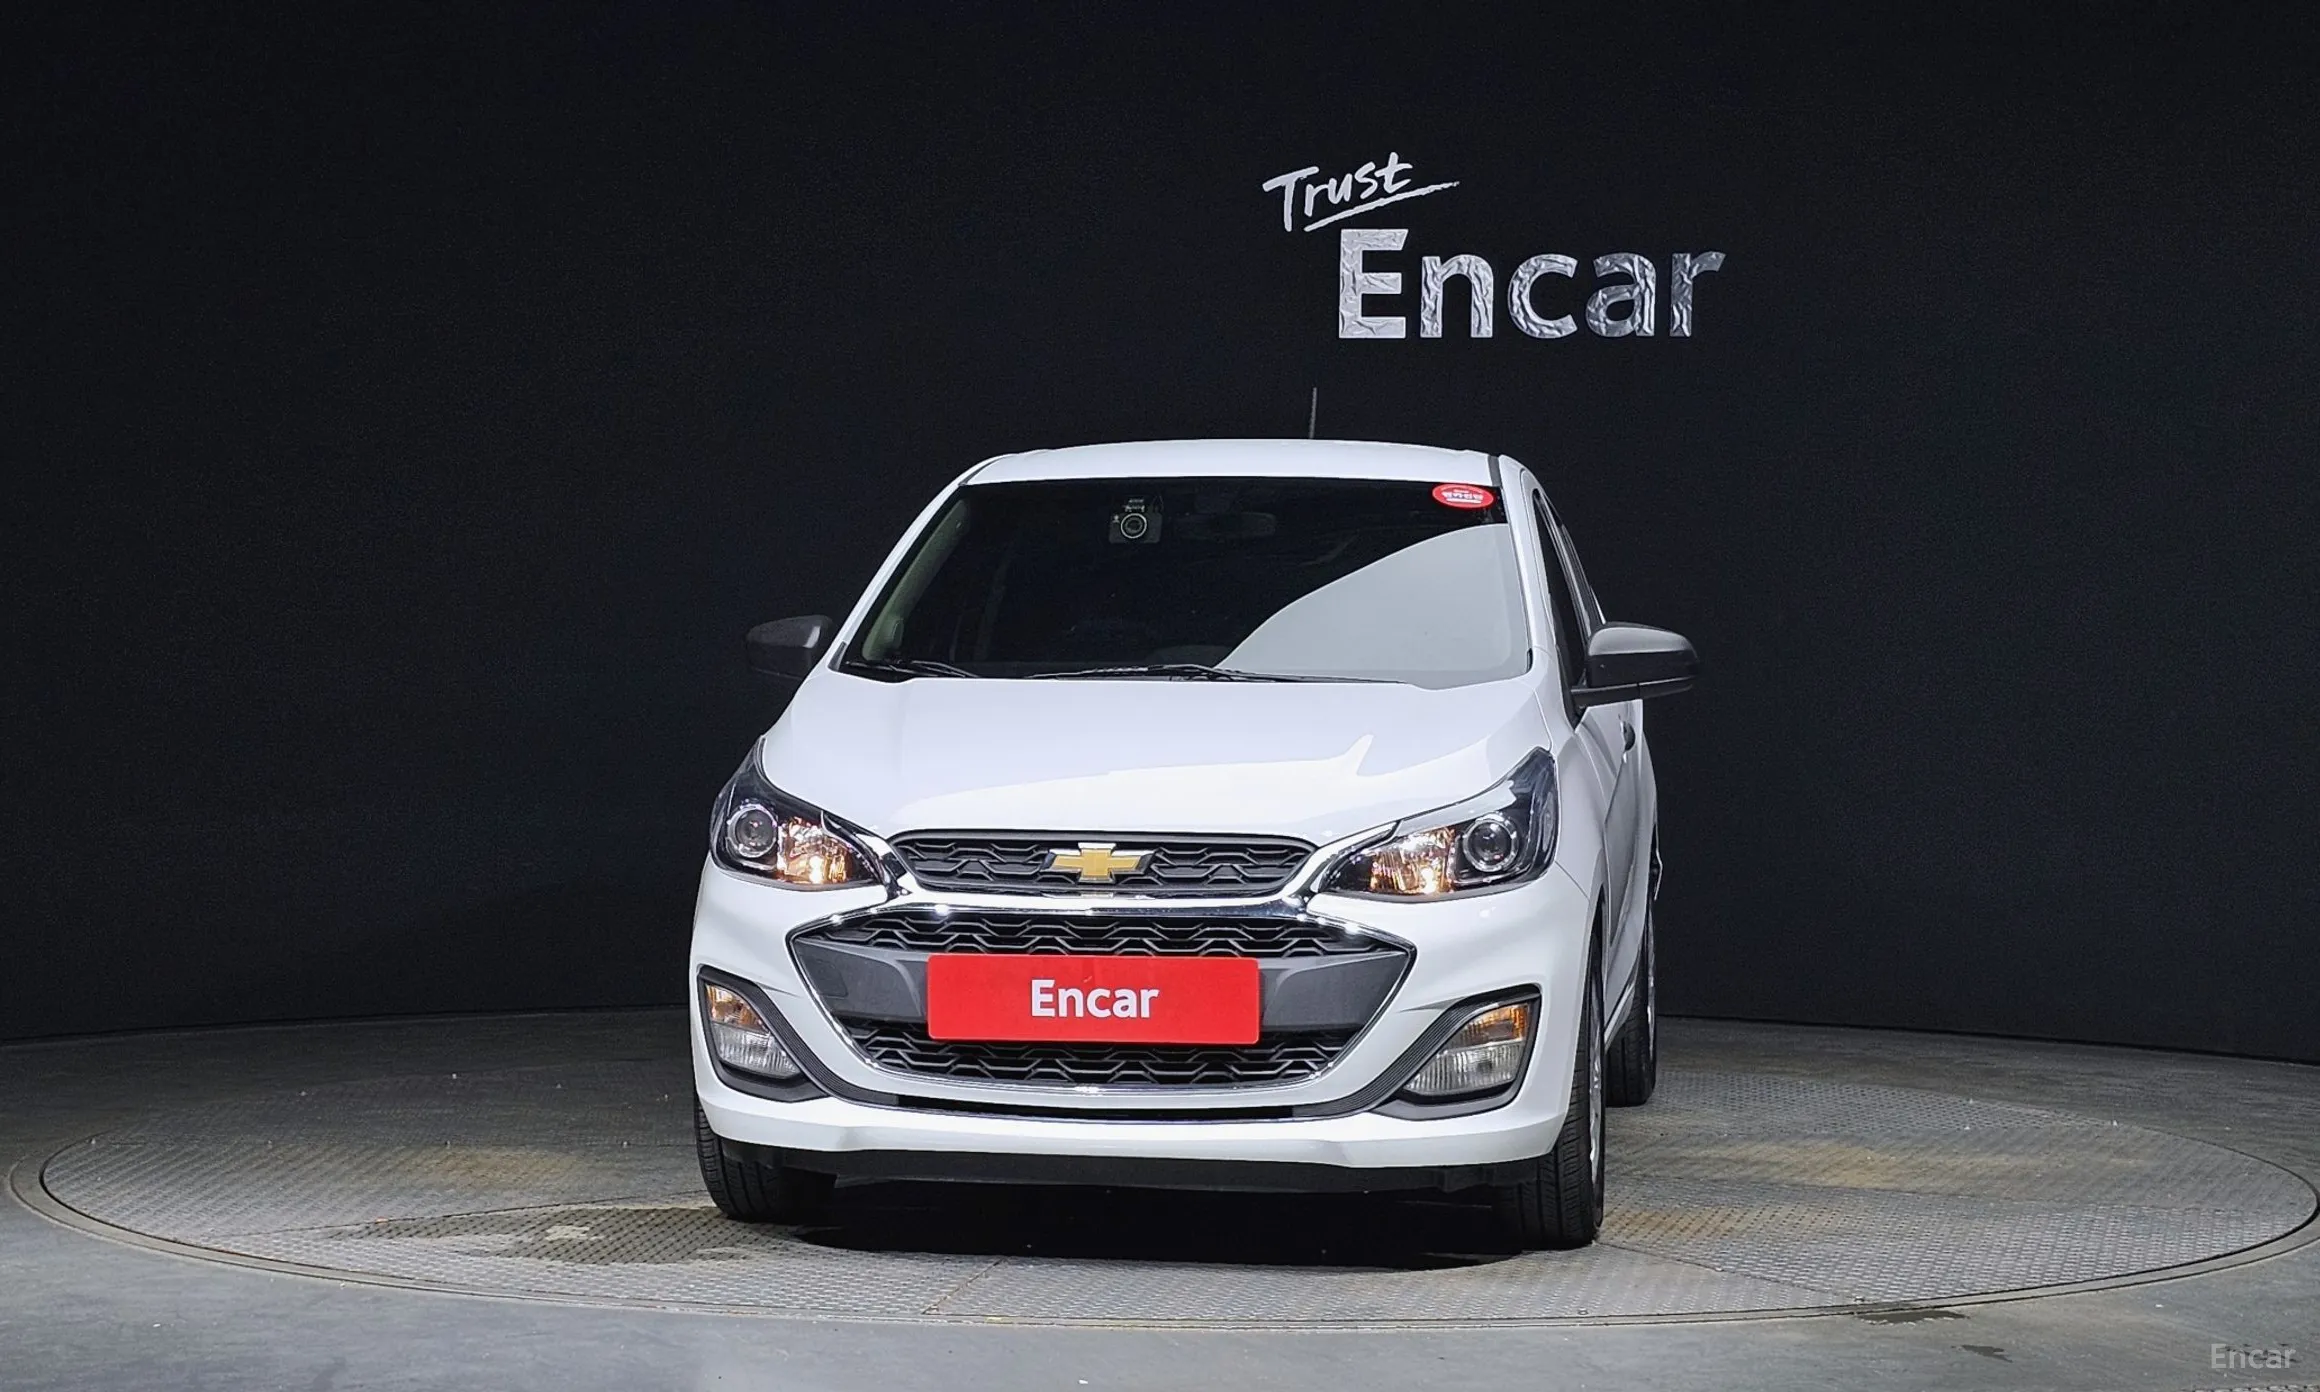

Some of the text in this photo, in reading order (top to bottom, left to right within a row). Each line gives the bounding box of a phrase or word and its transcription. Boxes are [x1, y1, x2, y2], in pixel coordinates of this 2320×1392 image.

[1262, 152, 1413, 232] Trust
[1339, 228, 1726, 338] Encar
[1031, 979, 1160, 1018] Encar
